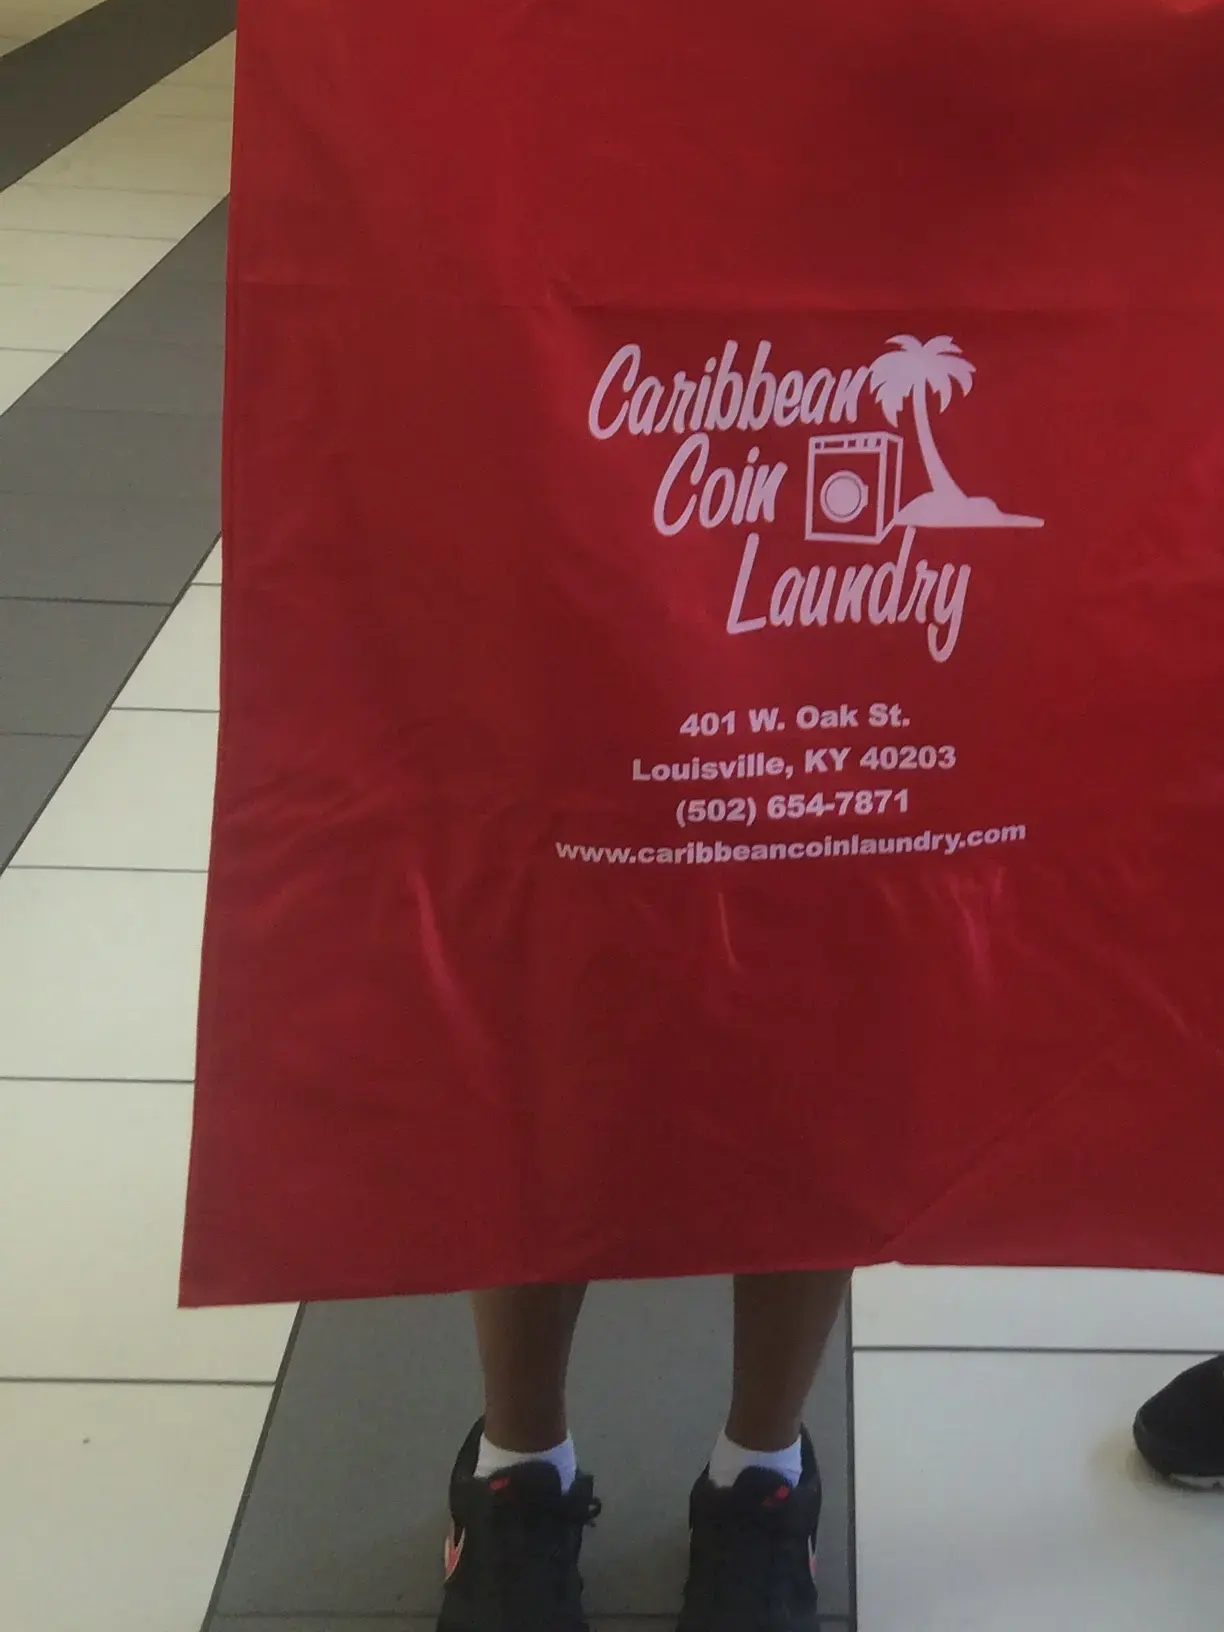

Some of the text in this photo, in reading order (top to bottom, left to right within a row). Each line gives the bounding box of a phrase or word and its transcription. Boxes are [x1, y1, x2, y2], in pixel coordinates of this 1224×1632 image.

[588, 339, 873, 440] Caribbean
[653, 432, 788, 537] Coin
[726, 526, 972, 664] Laundry
[679, 703, 911, 737] 401 W. Oak St.
[632, 745, 958, 782] Louisville, KY 40203
[676, 789, 908, 829] (502) 654-7871
[555, 825, 1027, 865] www.caribbeancoinlaundry.com
